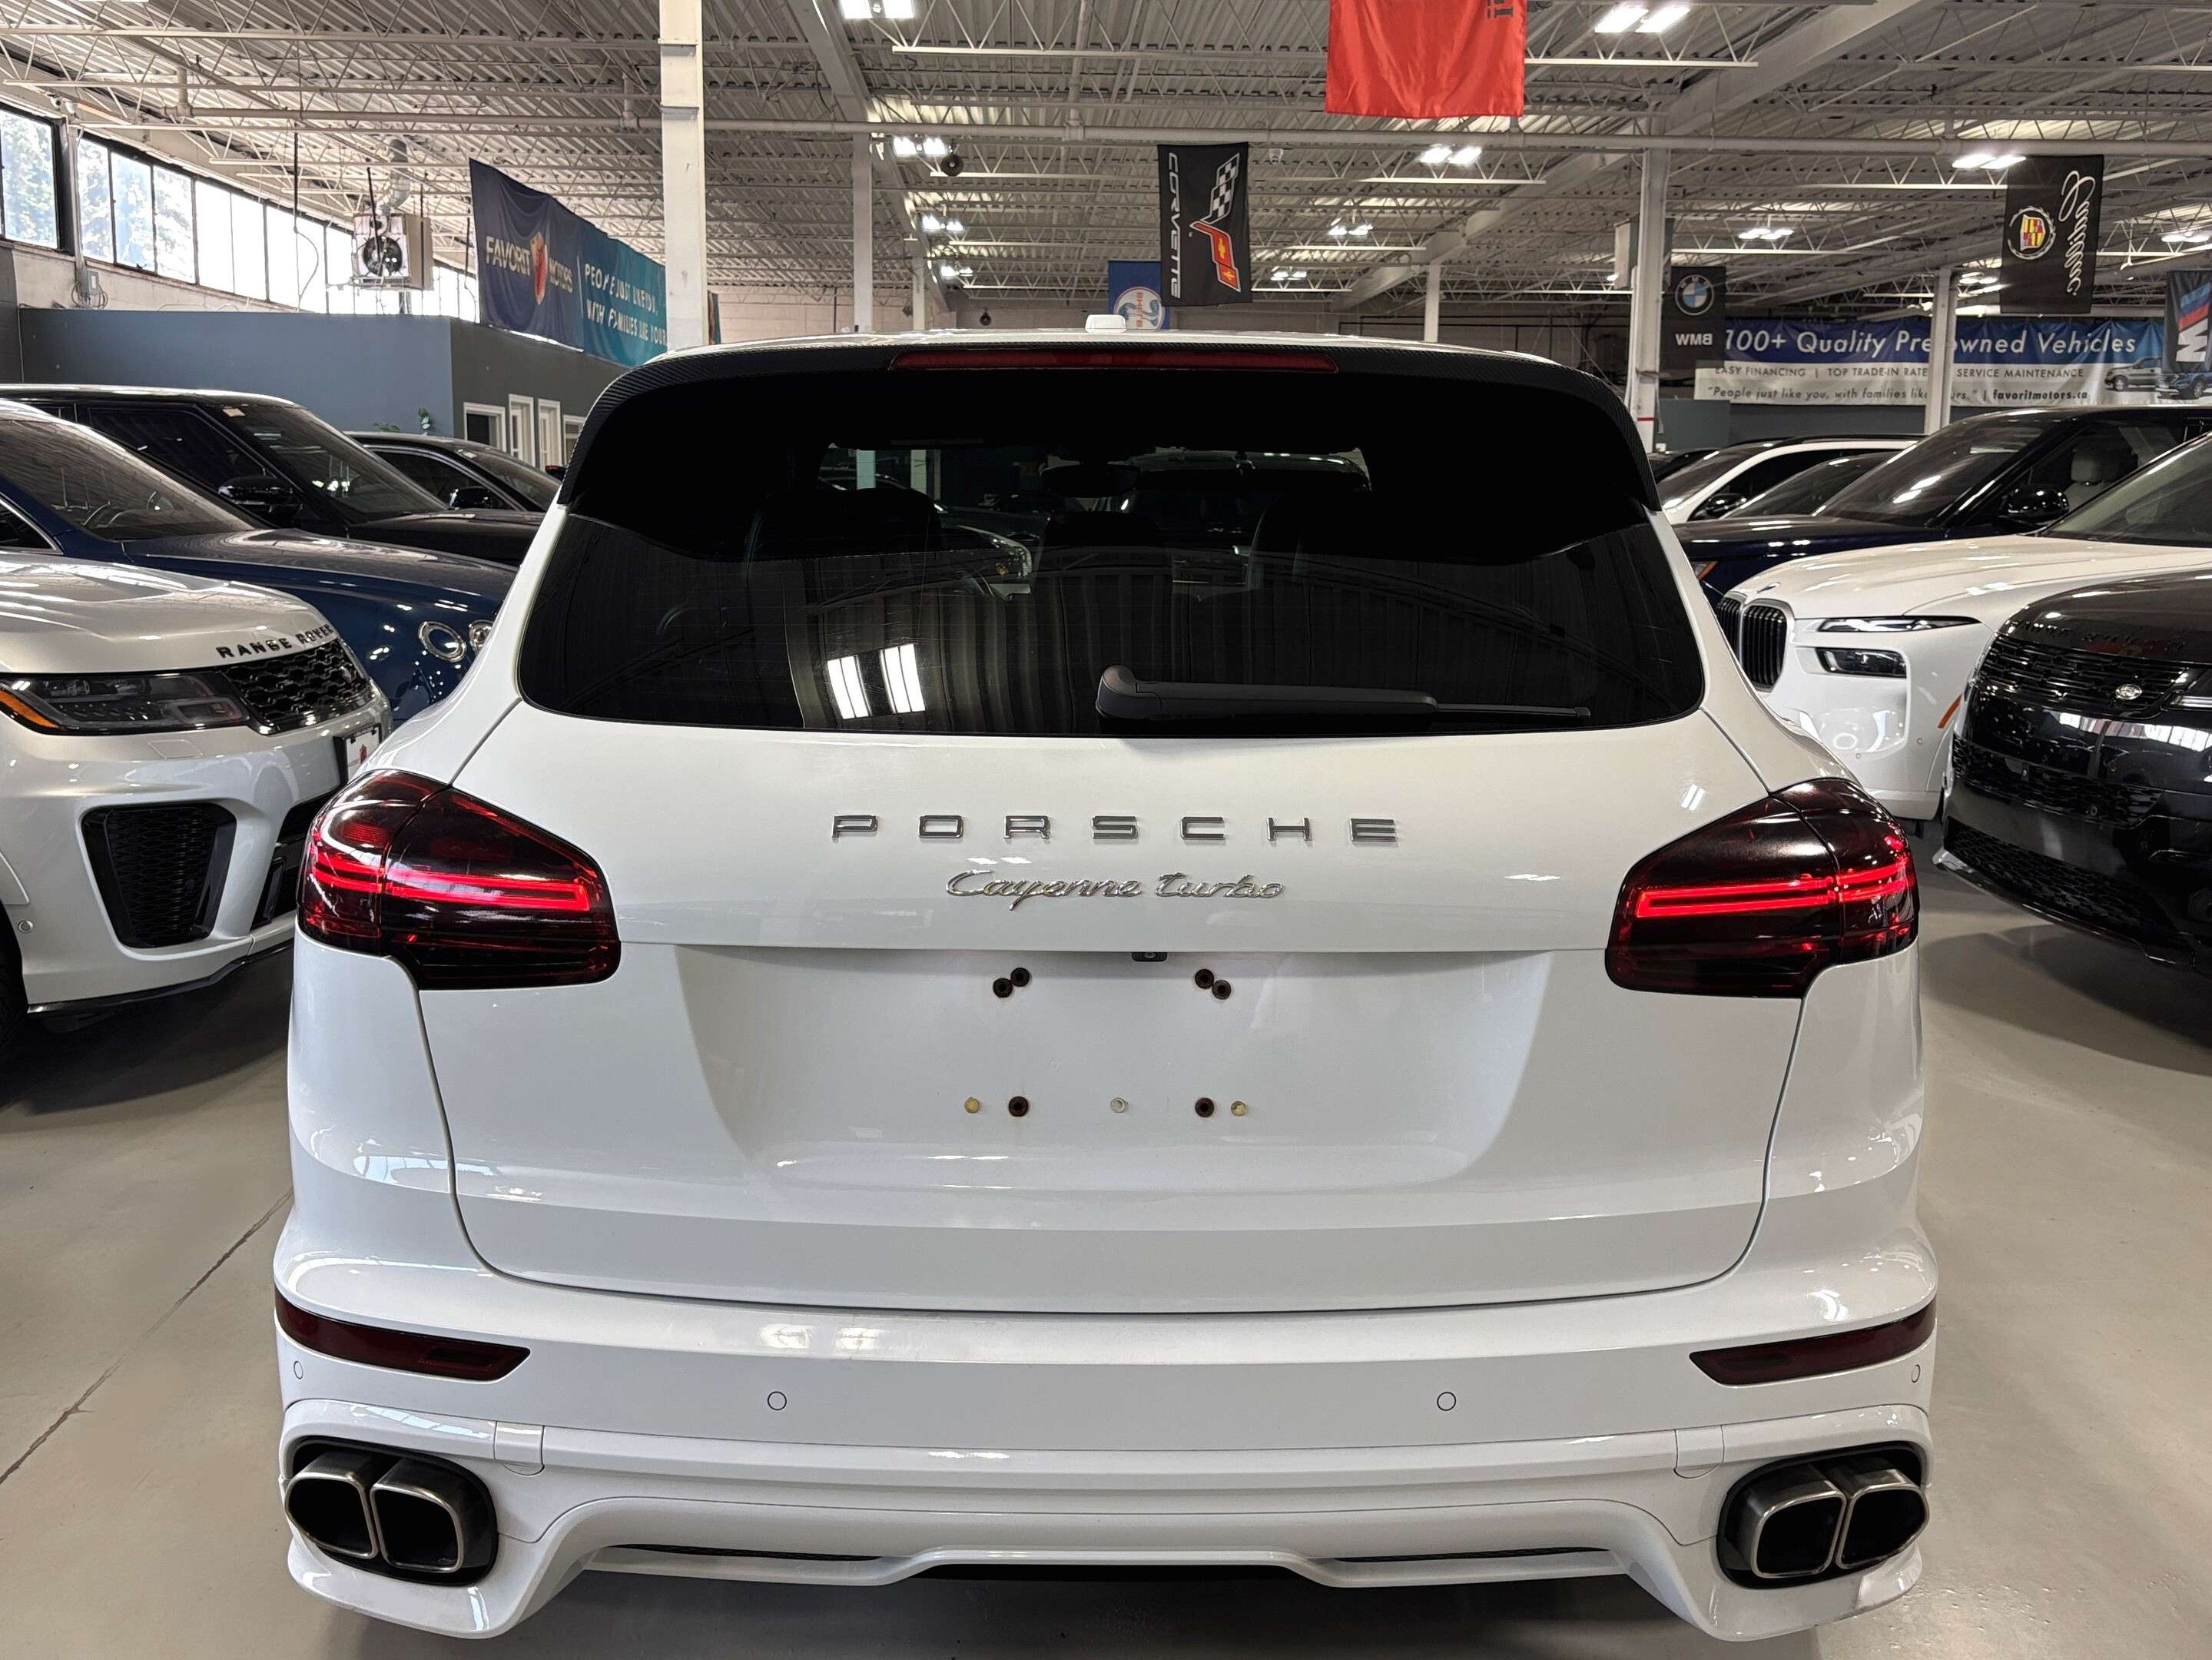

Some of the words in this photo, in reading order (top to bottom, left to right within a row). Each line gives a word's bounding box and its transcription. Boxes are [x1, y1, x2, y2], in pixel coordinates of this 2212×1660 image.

[1169, 153, 1181, 299] CORVETTE
[486, 235, 530, 277] FAVORIT
[1725, 329, 1787, 352] 100+
[1796, 330, 1887, 358] Quality
[2038, 328, 2136, 354] Vehicles
[1745, 367, 1806, 377] FINANCING
[1852, 367, 1899, 377] TRADE-IN
[1904, 367, 1928, 377] RATE
[1956, 368, 2000, 378] SERVICE
[2004, 369, 2084, 378] MAINTENANCE
[1755, 390, 1779, 400] just
[1781, 387, 1802, 399] like
[1835, 387, 1858, 398] with
[1862, 387, 1907, 399] families
[1992, 389, 2088, 400] favoritmotors.ca
[215, 638, 293, 659] RANGE
[832, 815, 1399, 842] PORSCHE
[945, 870, 1143, 911] Cayenne
[1155, 873, 1284, 898] turbo
